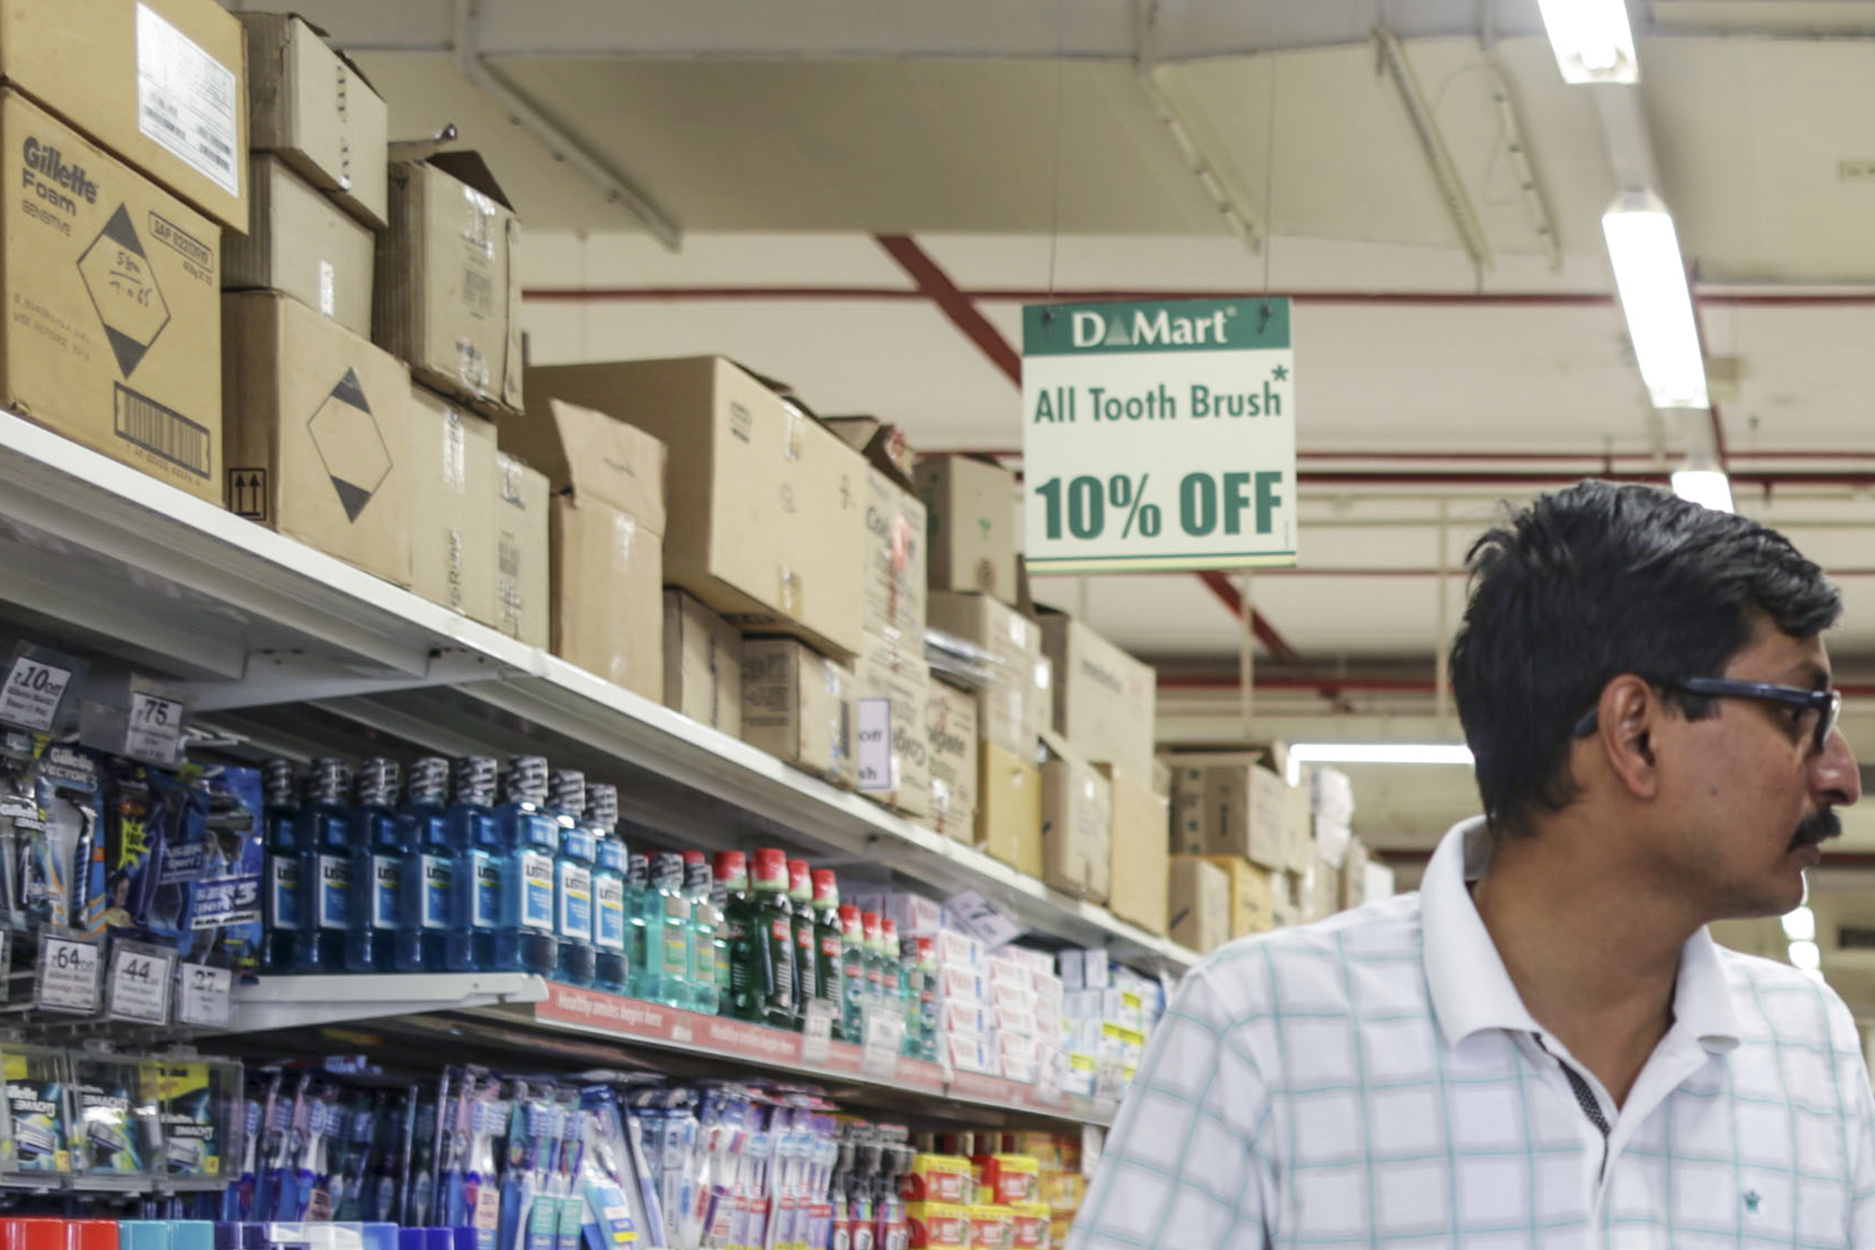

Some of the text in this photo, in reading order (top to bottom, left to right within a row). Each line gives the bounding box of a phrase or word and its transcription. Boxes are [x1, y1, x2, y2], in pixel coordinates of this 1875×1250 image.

[22, 168, 77, 216] Foam
[23, 137, 97, 204] Gillette
[1035, 387, 1075, 424] All
[1089, 384, 1176, 422] Tooth
[1035, 471, 1282, 540] 10% OFF
